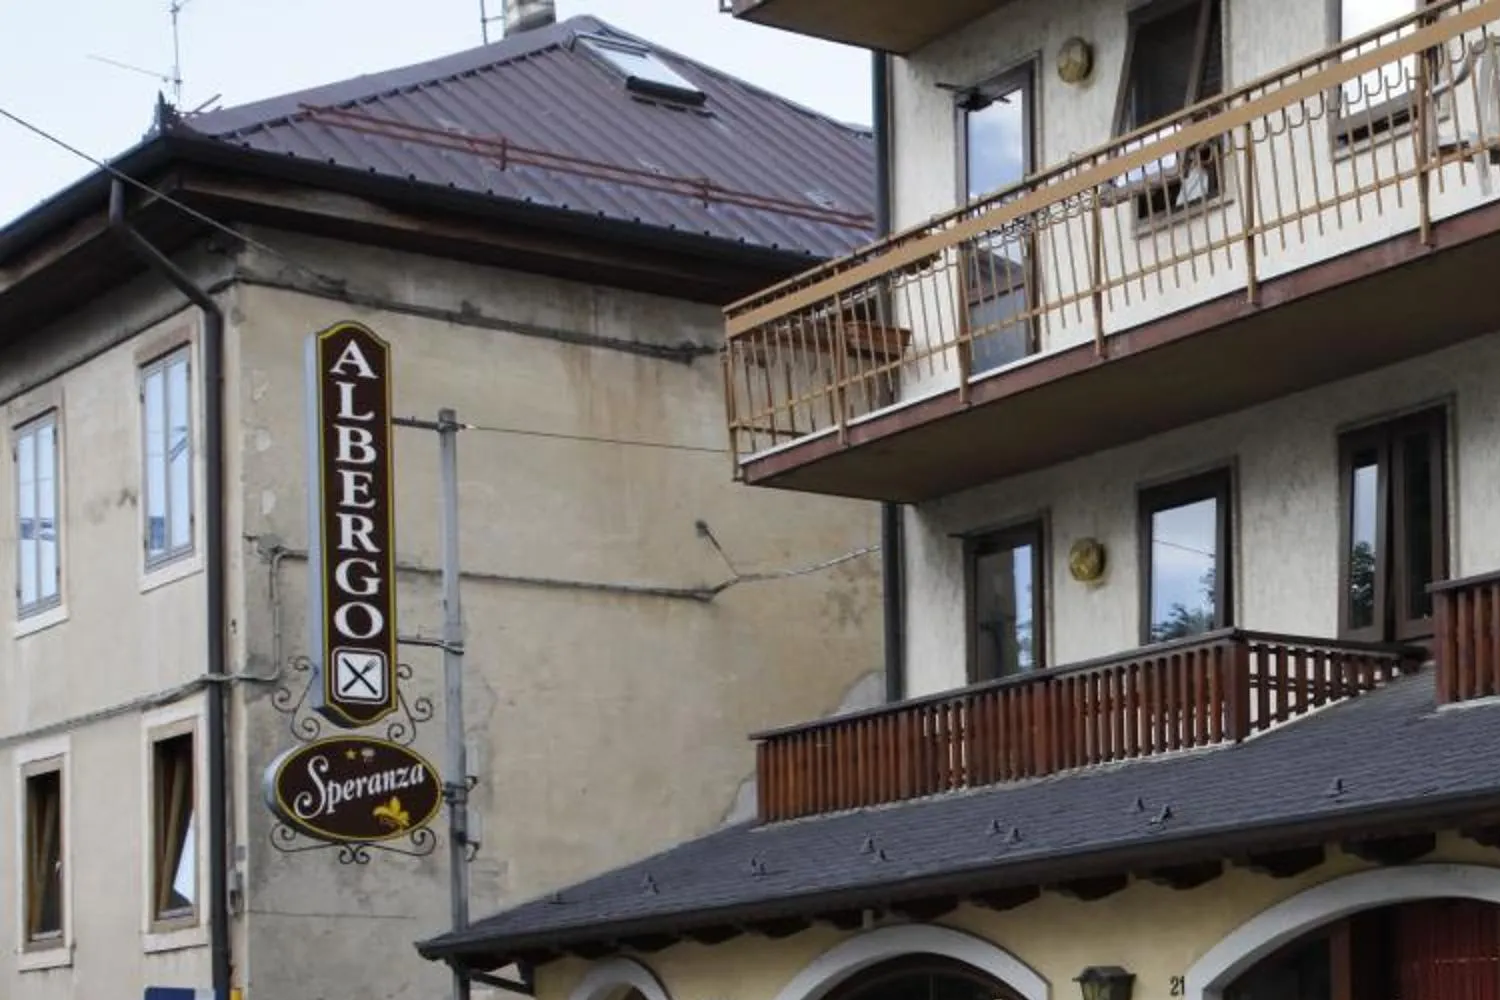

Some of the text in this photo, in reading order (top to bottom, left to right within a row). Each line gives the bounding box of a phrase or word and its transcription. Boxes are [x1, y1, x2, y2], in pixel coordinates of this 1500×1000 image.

[330, 339, 384, 639] ALBERGO
[294, 755, 425, 819] Speranza
[1170, 975, 1185, 996] 21
